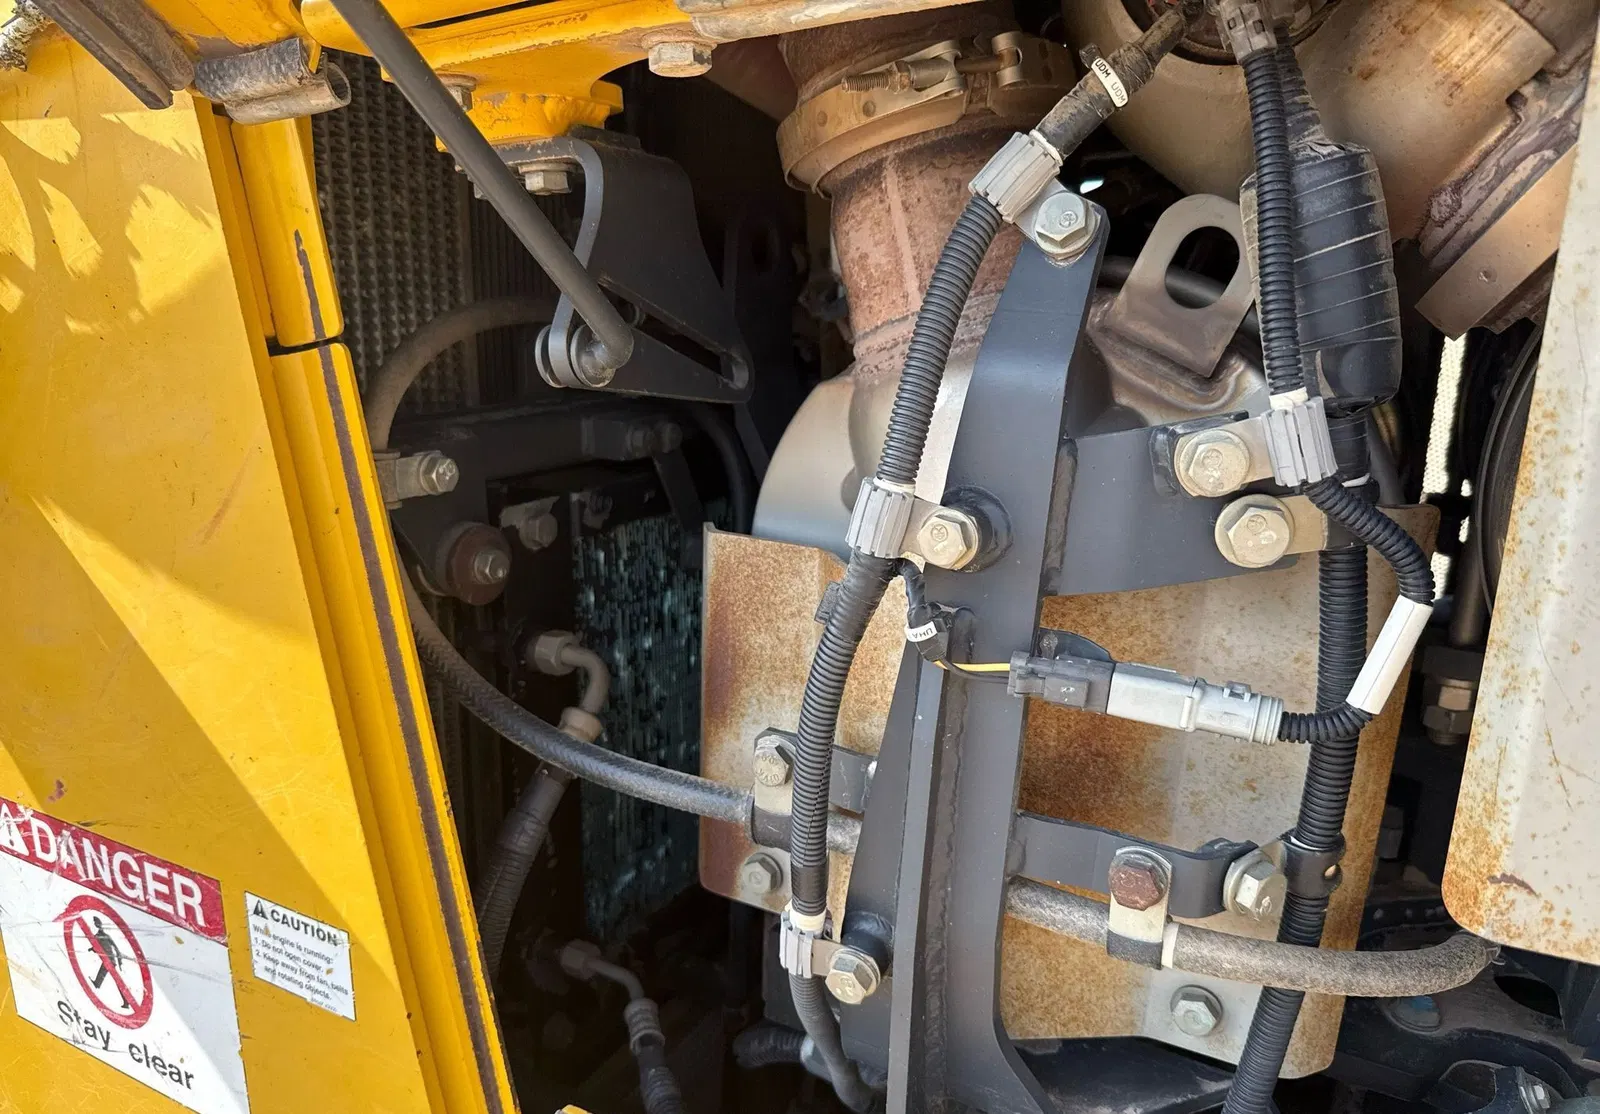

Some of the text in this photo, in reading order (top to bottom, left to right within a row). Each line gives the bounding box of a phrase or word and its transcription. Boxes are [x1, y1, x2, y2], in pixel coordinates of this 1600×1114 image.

[1095, 60, 1126, 103] UDM UDM
[30, 816, 207, 927] DANGER
[270, 909, 338, 947] CAUTION
[262, 940, 271, 950] Do
[272, 945, 283, 955] not
[284, 951, 301, 962] open
[263, 952, 279, 966] Keep
[281, 961, 298, 974] away
[272, 933, 295, 947] engine
[303, 947, 334, 965] running:
[57, 1000, 195, 1090] Stay clear
